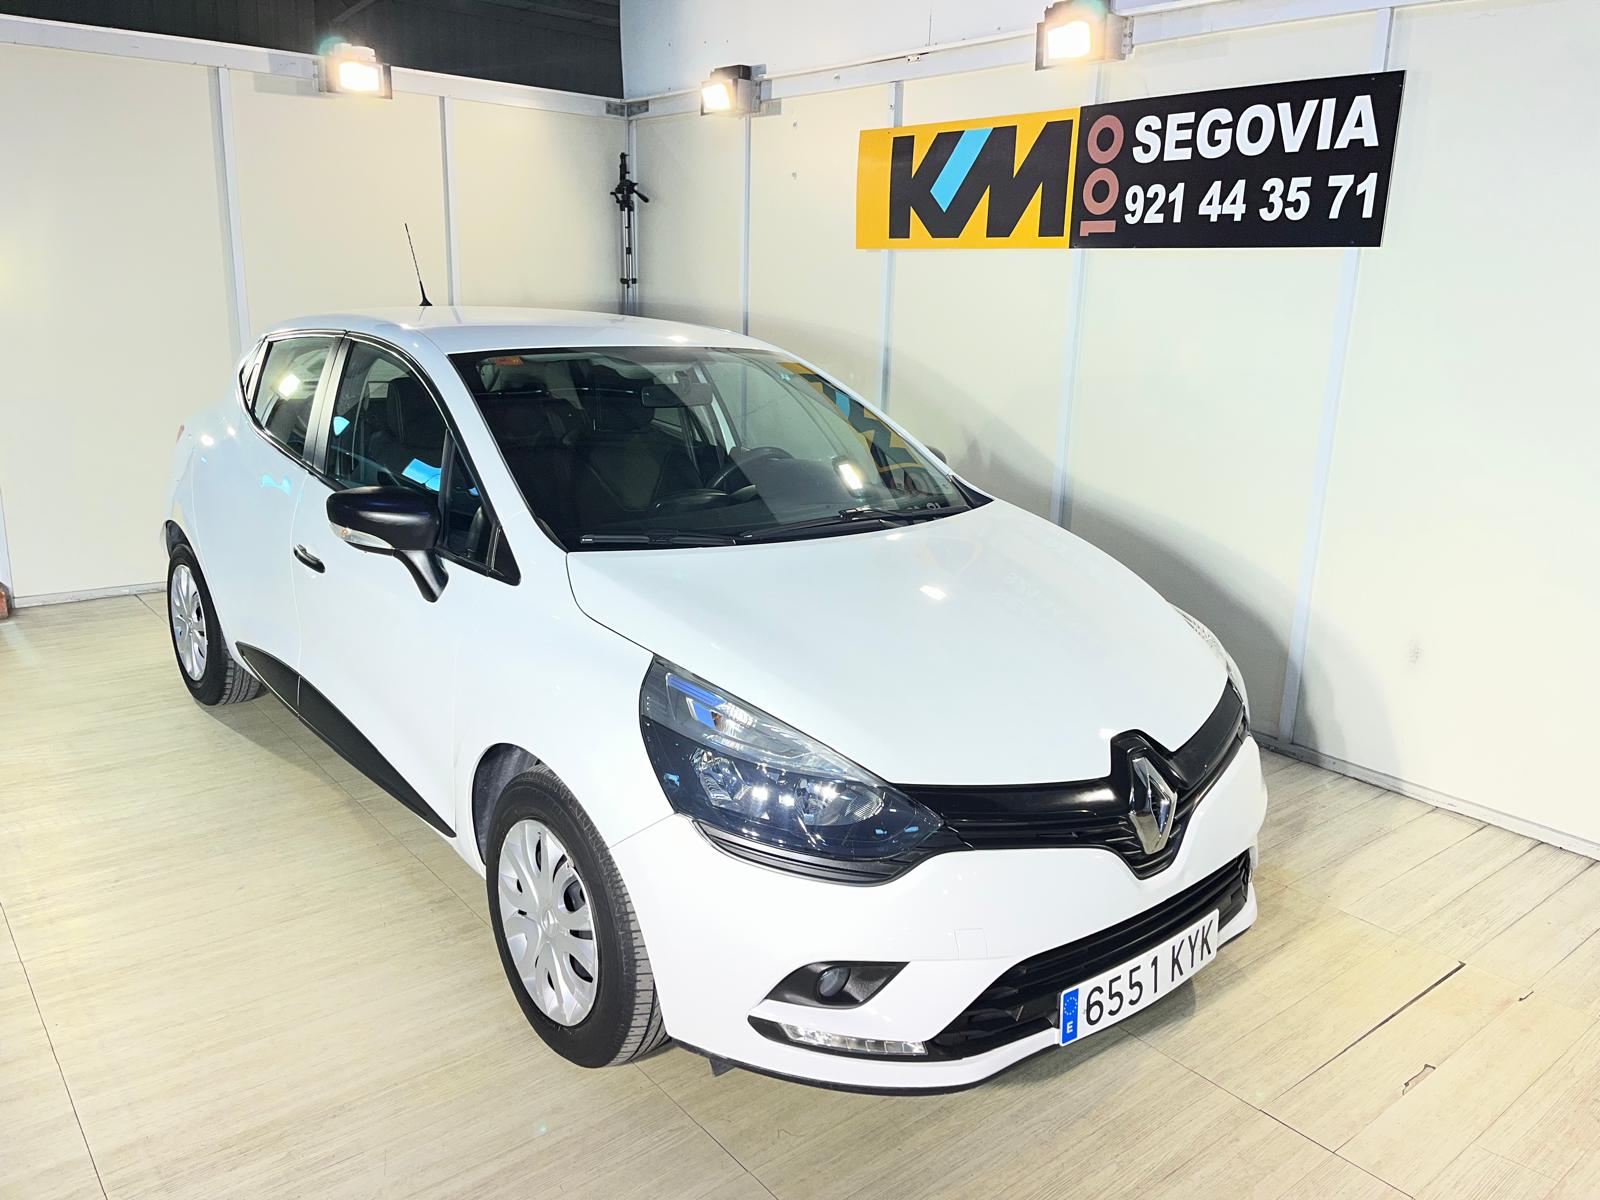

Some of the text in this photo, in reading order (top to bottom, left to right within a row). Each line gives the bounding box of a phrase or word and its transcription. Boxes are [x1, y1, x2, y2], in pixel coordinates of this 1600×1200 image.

[1132, 95, 1379, 163] SEGOVIA
[888, 119, 1074, 239] KM
[1079, 114, 1125, 237] 100
[1124, 172, 1379, 225] 921 44 35 71
[1086, 919, 1213, 1025] 6551 KYK
[1066, 1020, 1074, 1034] E
